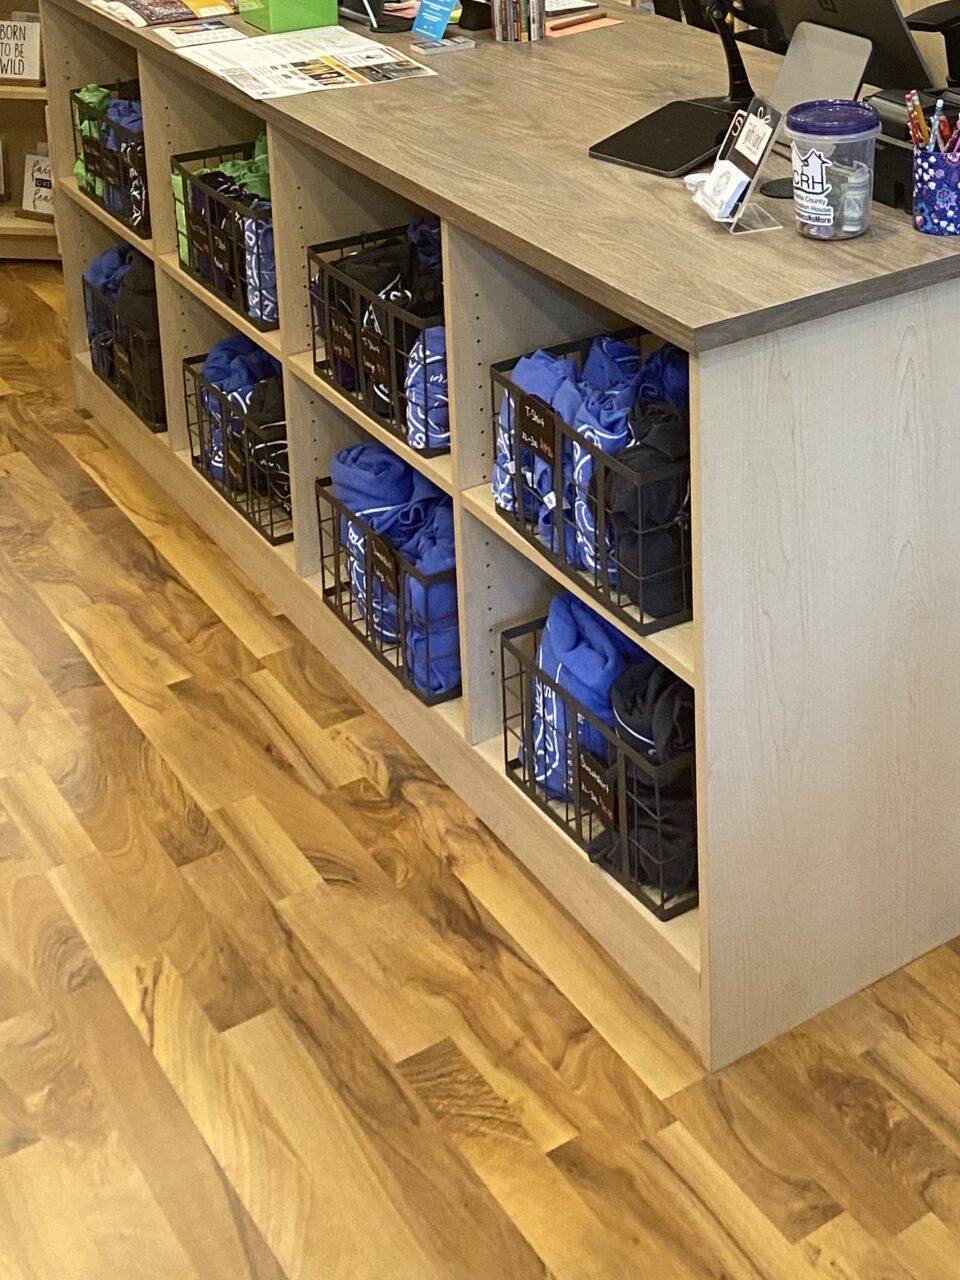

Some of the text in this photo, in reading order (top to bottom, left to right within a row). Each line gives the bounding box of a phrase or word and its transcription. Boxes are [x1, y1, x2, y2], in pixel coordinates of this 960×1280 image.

[0, 25, 26, 41] BORN
[0, 42, 24, 59] TO BE
[0, 59, 25, 76] WILD
[805, 196, 826, 205] County
[811, 205, 832, 213] House
